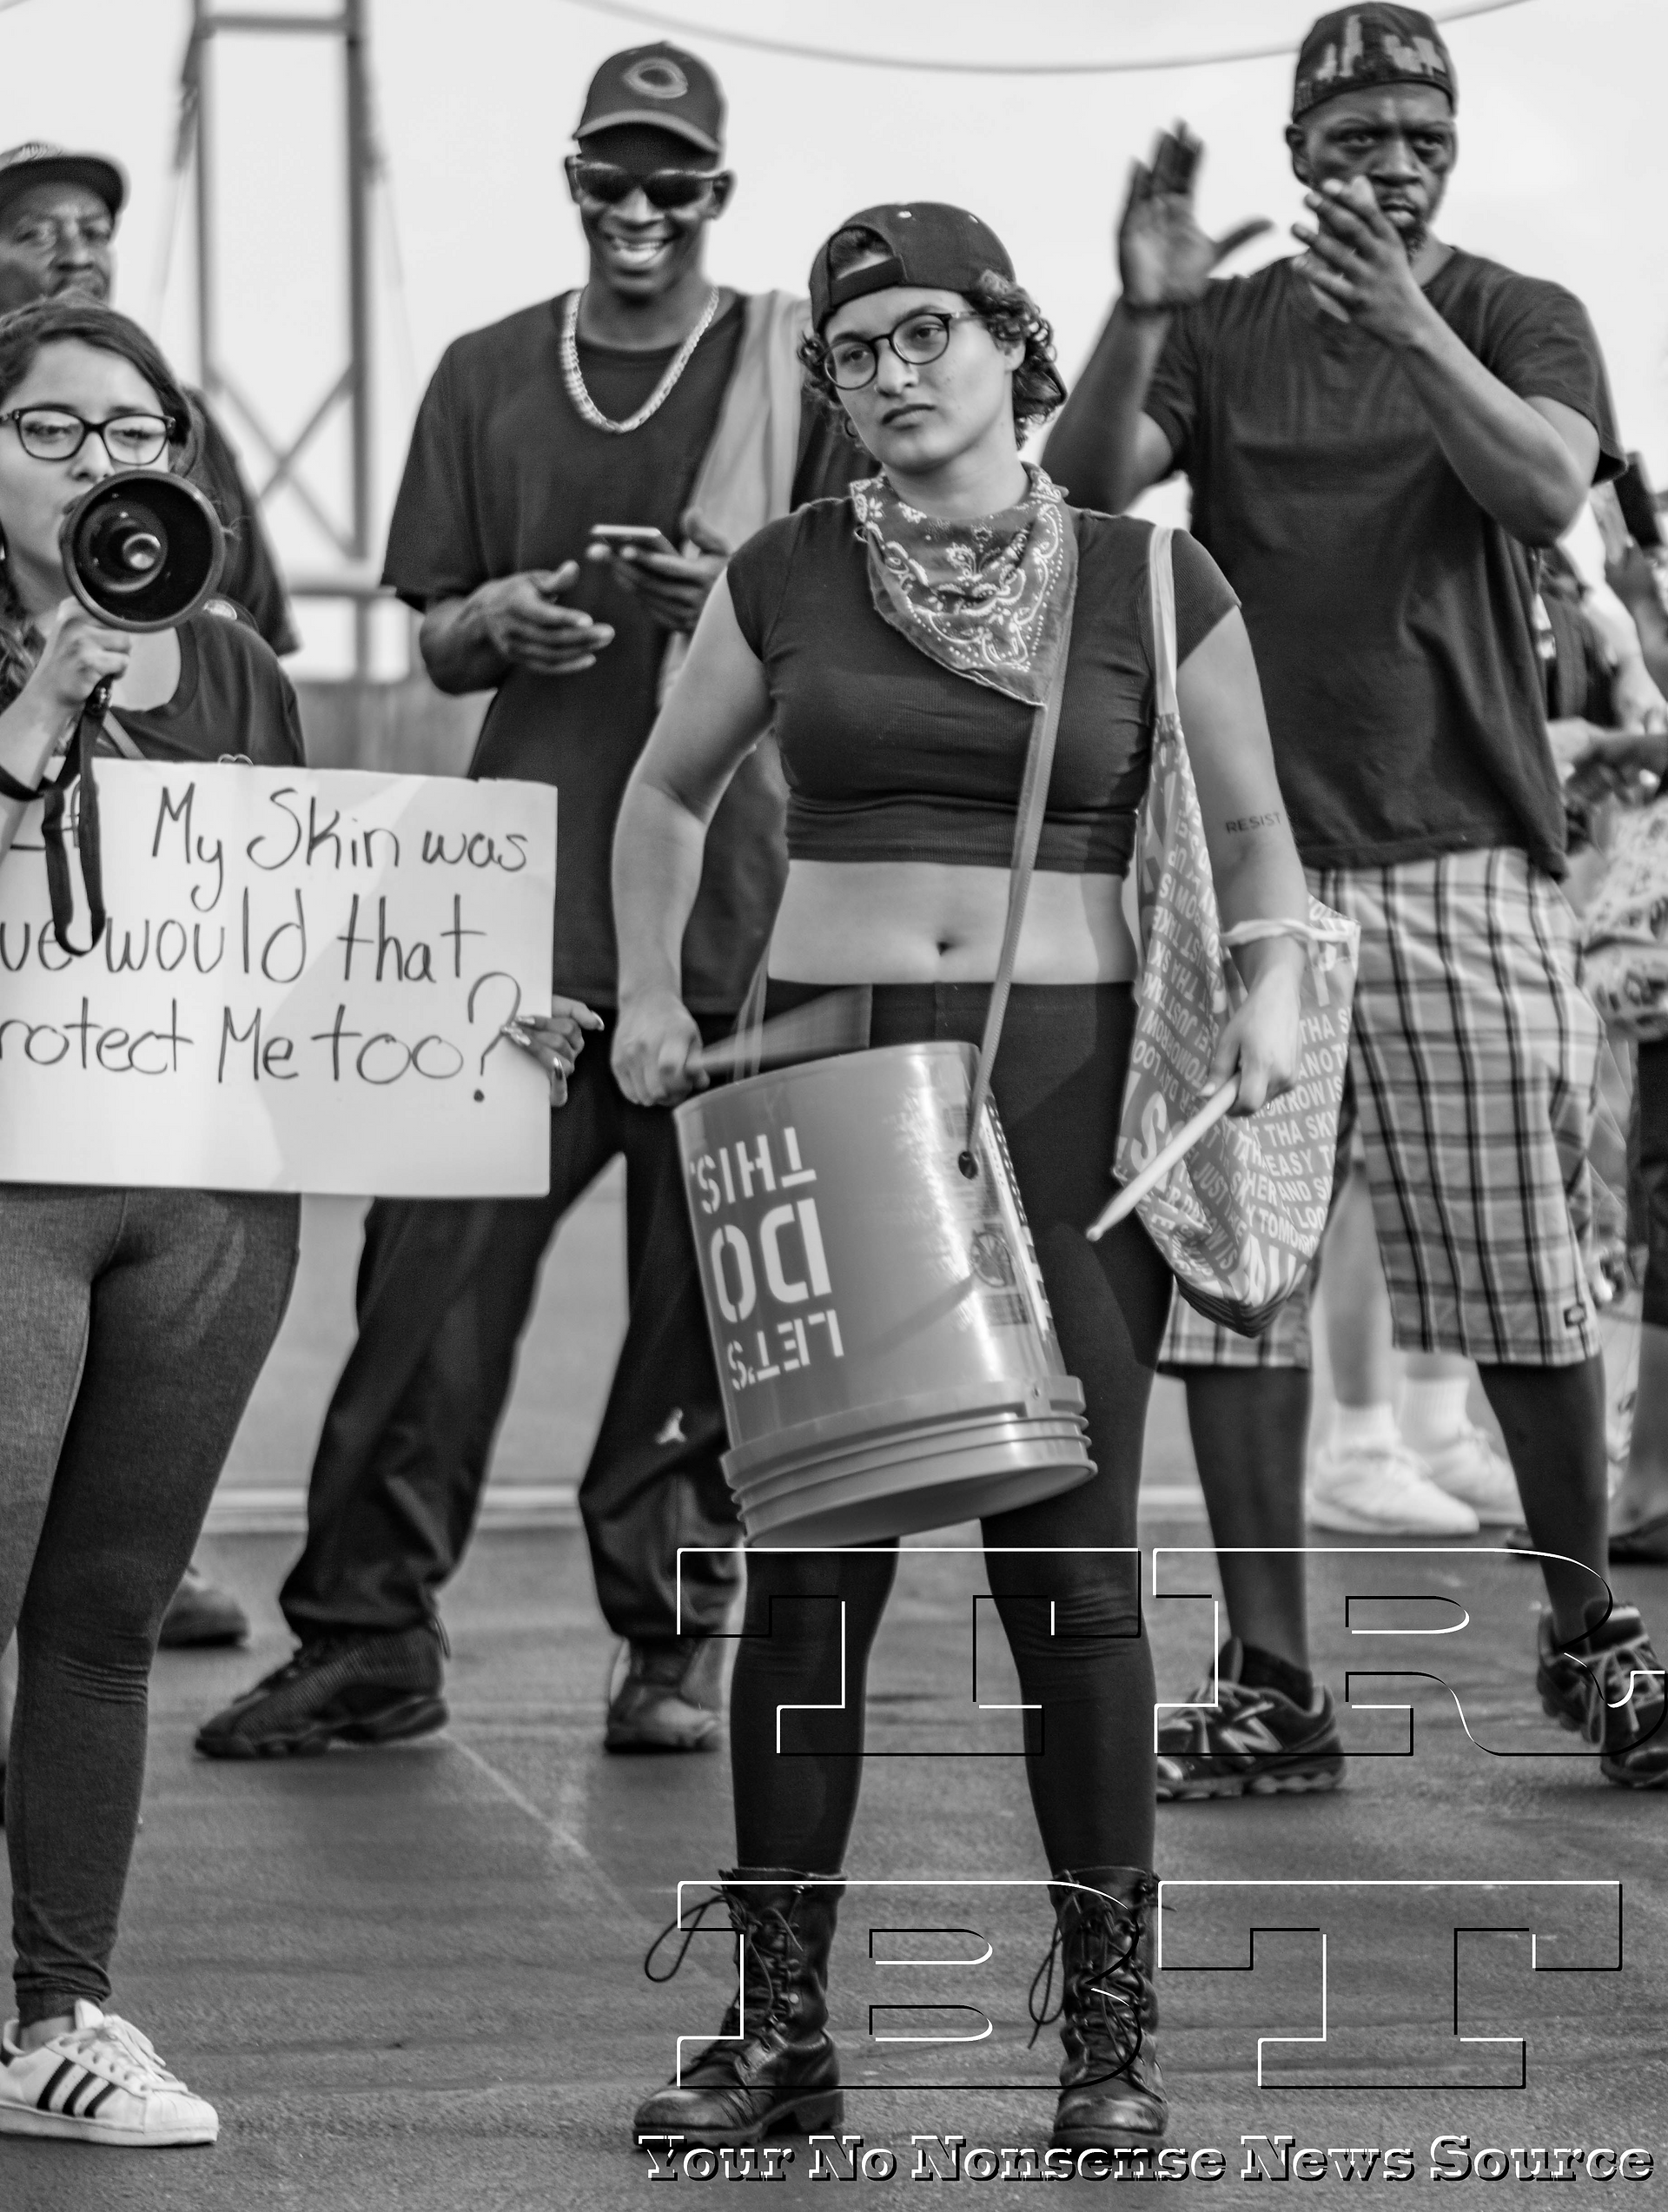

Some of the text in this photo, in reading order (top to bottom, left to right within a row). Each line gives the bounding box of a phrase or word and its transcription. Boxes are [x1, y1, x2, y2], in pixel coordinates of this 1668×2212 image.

[1225, 811, 1281, 834] RESIST
[152, 781, 223, 912] My
[422, 828, 528, 871] was
[105, 886, 307, 983] would
[337, 893, 487, 982] that
[0, 996, 194, 1075] rotect
[218, 1005, 299, 1083] Me
[1299, 1013, 1336, 1045] THA
[1132, 1039, 1162, 1076] LOO
[1264, 1119, 1306, 1148] THA
[1305, 1109, 1338, 1140] SKY
[692, 1126, 817, 1215] THIS
[1264, 1147, 1314, 1177] EASY
[1275, 1179, 1313, 1202] AND
[1294, 1205, 1329, 1231] LOO
[710, 1197, 832, 1324] DO
[726, 1308, 845, 1391] LET'S
